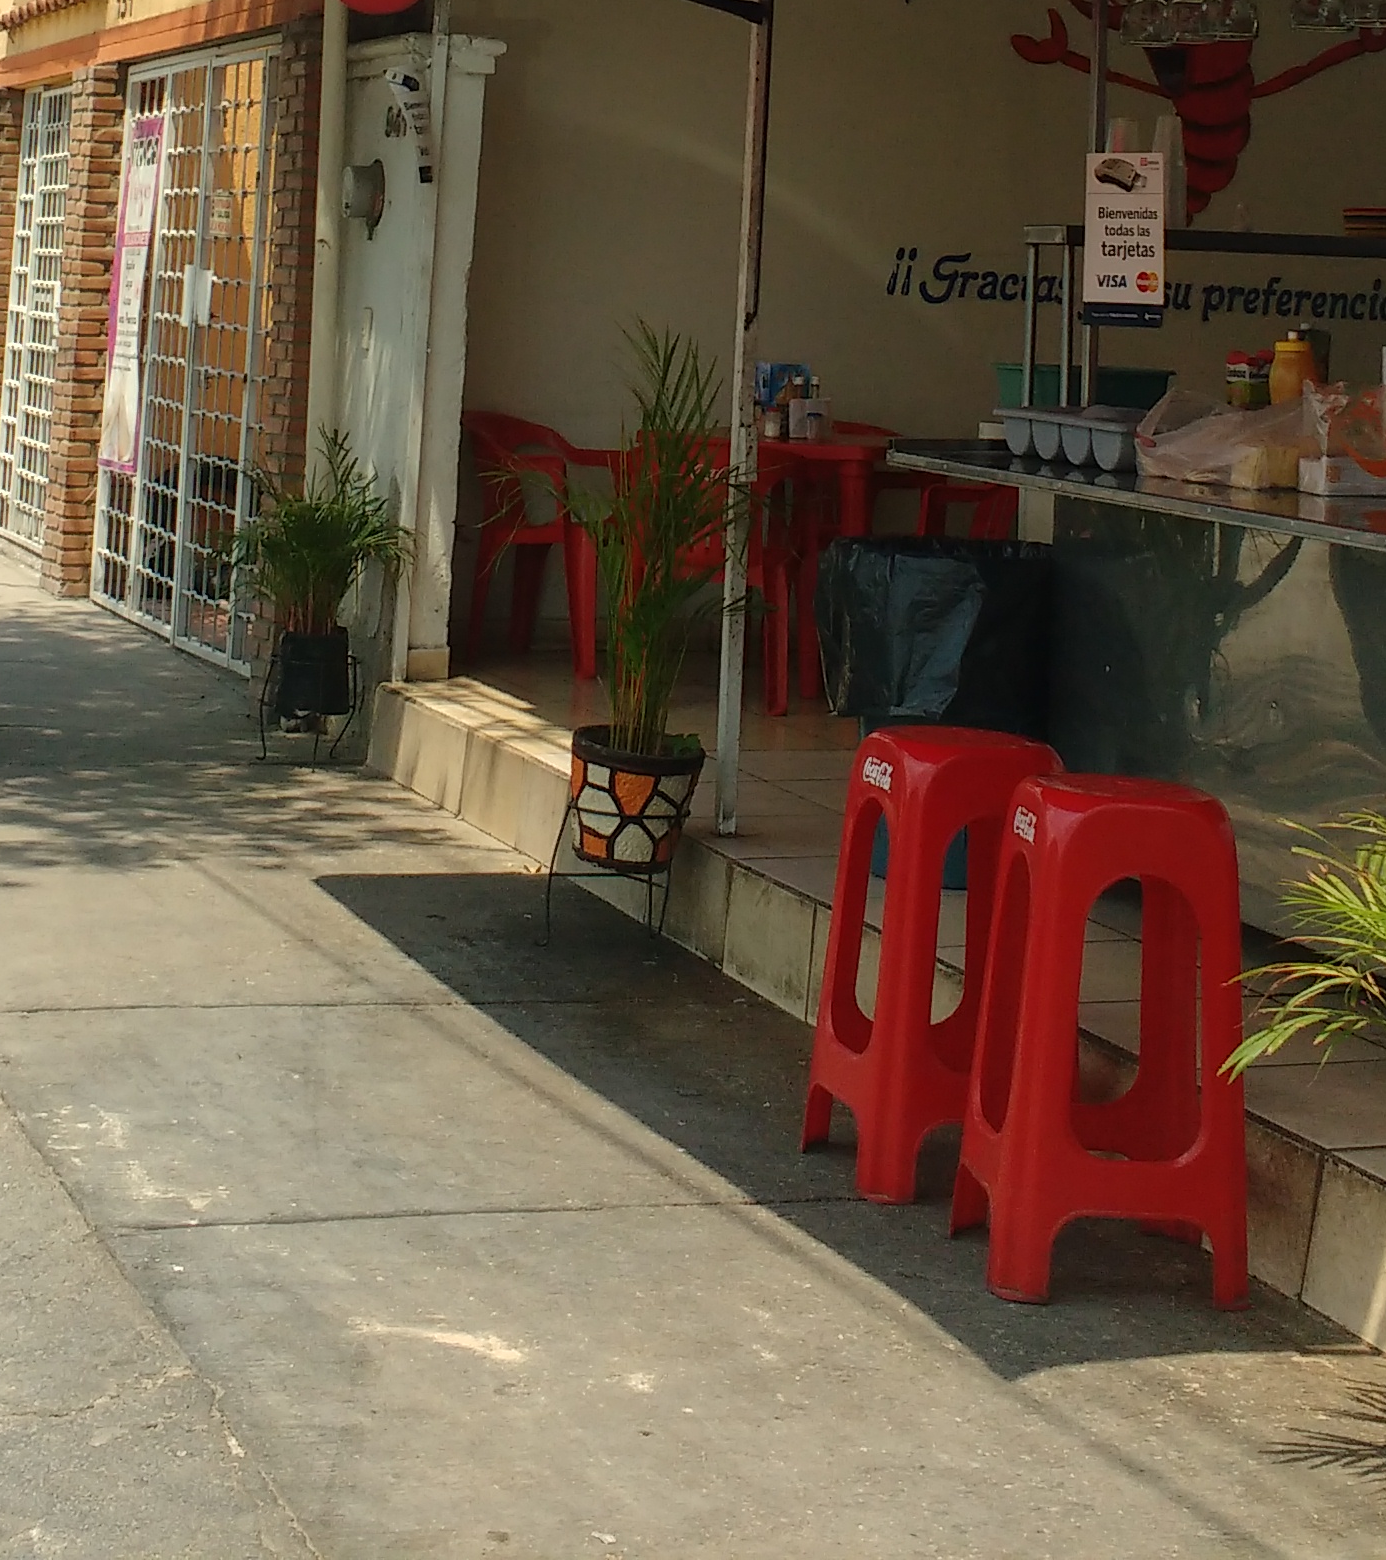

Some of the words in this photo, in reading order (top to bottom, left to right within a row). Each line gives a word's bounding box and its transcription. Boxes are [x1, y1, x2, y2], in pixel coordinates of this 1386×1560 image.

[1097, 206, 1159, 220] Bienvenidas
[1104, 224, 1135, 237] todas
[1137, 224, 1151, 237] las
[1101, 241, 1156, 261] tarjetas
[1096, 274, 1128, 288] VISA
[1163, 279, 1192, 312] su
